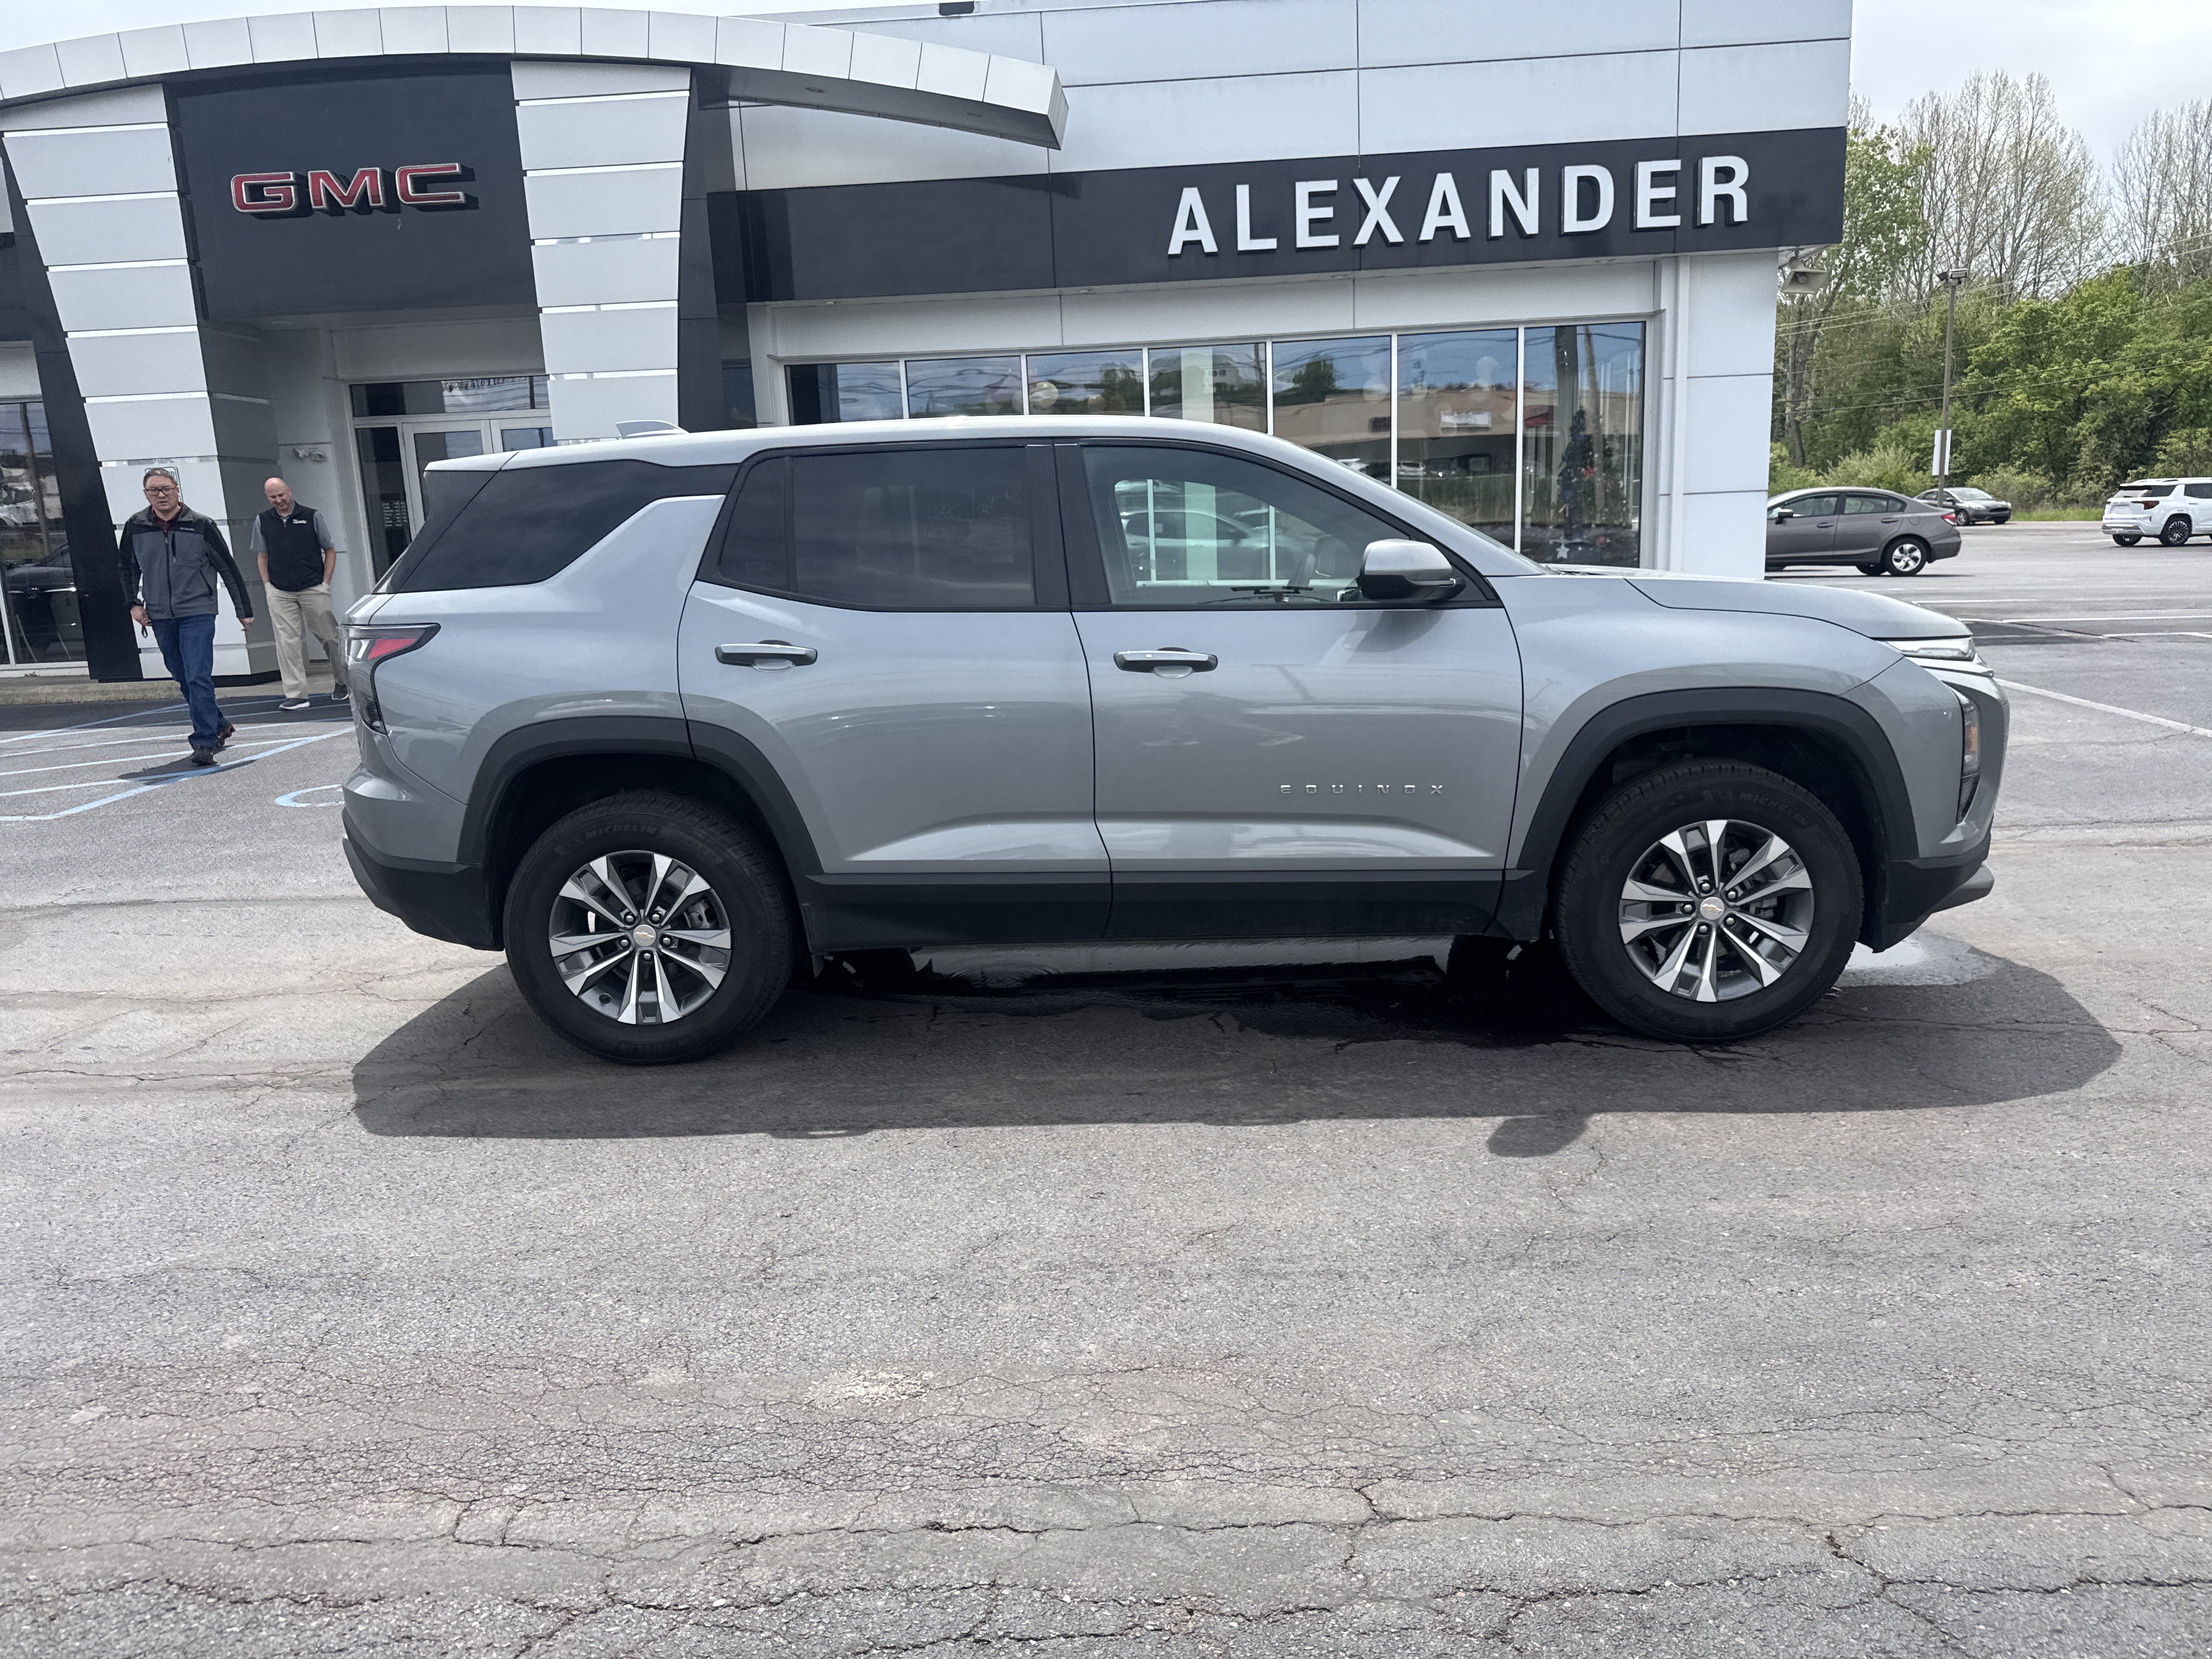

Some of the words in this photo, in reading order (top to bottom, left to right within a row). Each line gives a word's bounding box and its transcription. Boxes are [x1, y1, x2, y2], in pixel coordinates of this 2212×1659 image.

[230, 162, 466, 213] GMC
[1167, 155, 1750, 256] ALEXANDER
[1280, 784, 1443, 795] EQUINOX
[1739, 791, 1812, 826] MICHELIN
[585, 822, 658, 840] MICHELIN
